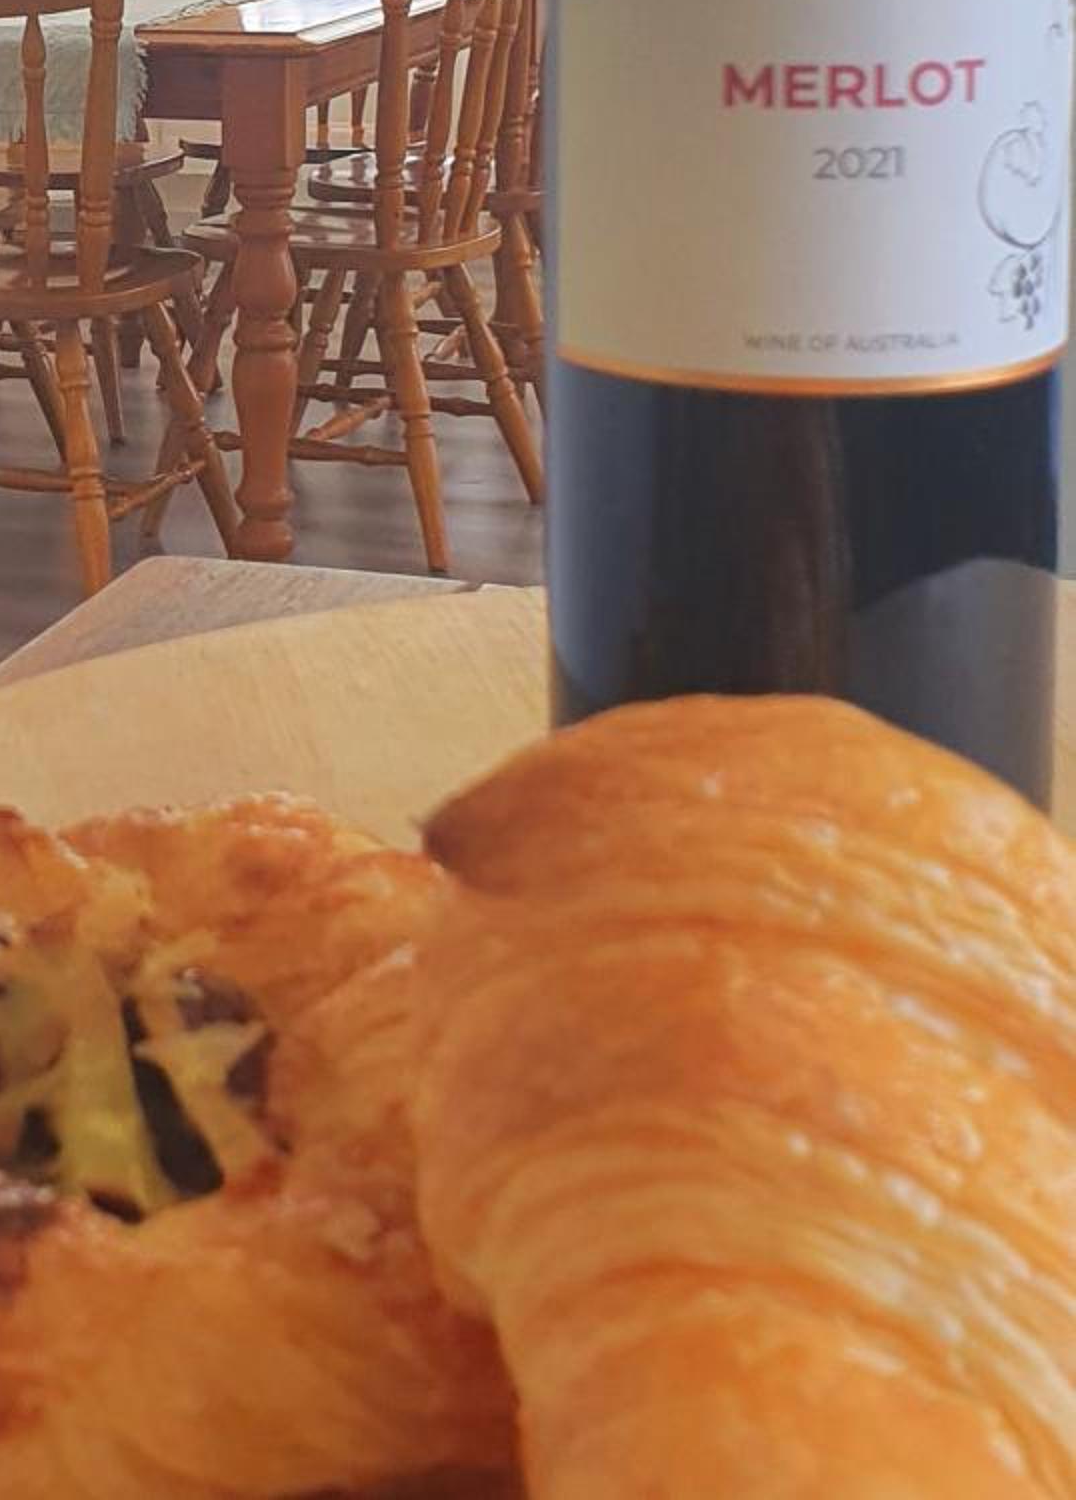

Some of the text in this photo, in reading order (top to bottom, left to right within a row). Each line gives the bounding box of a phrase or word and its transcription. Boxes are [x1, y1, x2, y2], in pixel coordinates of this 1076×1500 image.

[722, 59, 987, 109] MERLOT
[812, 145, 906, 179] 2021
[745, 333, 961, 351] WINE OF AUSTRALIA
